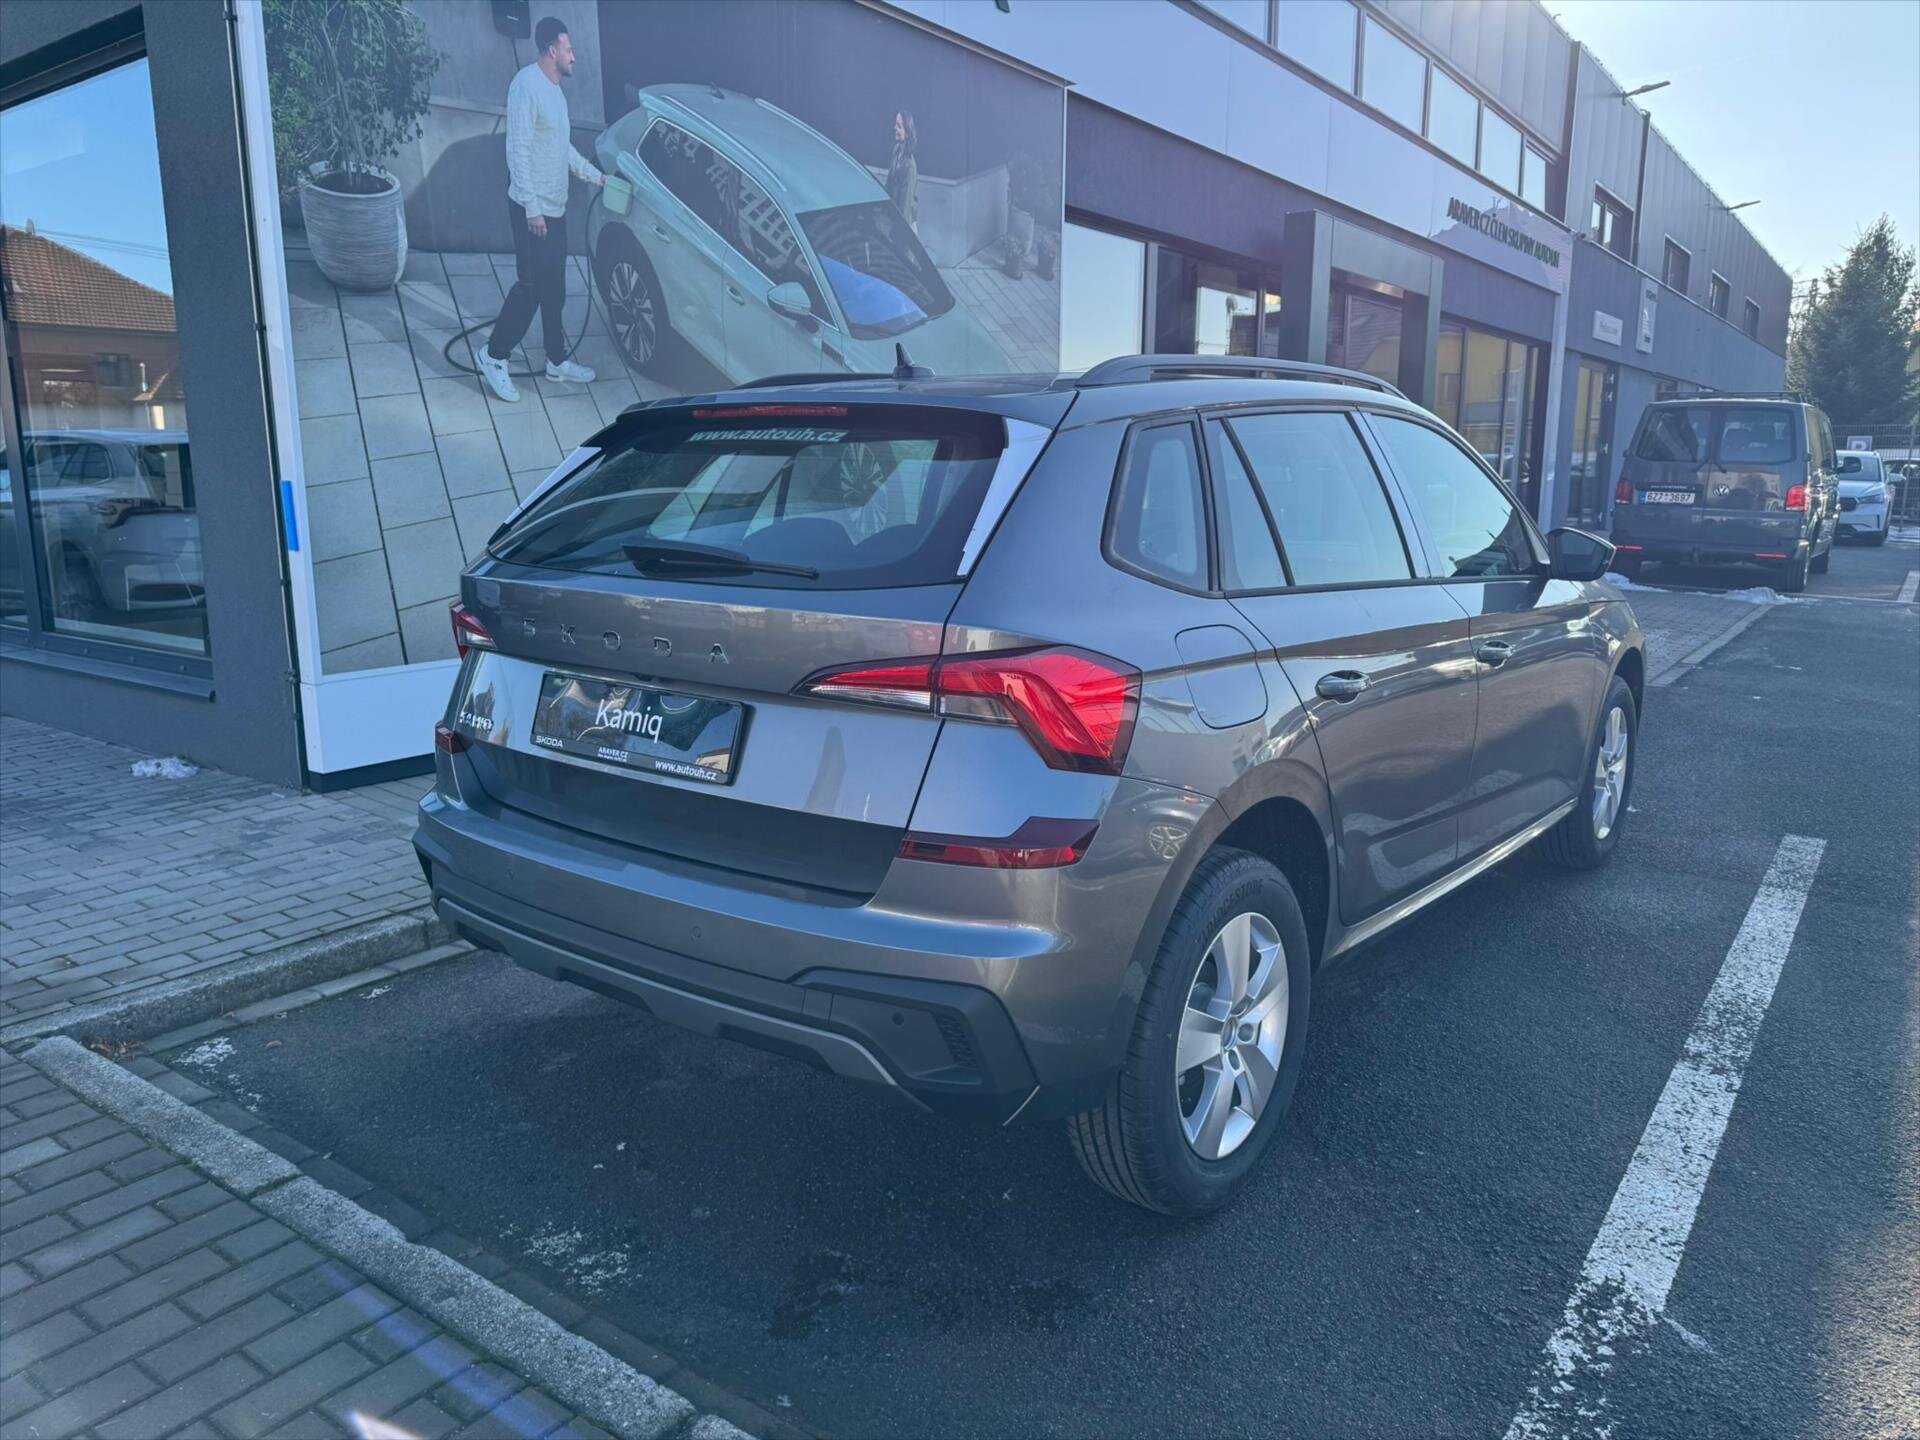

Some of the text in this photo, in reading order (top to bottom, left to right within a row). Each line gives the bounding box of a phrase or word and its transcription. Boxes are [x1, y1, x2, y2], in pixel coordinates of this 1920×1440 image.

[688, 428, 848, 442] www.autouh.cz
[595, 698, 663, 744] Kamiq
[655, 760, 717, 781] www.autouh.cz
